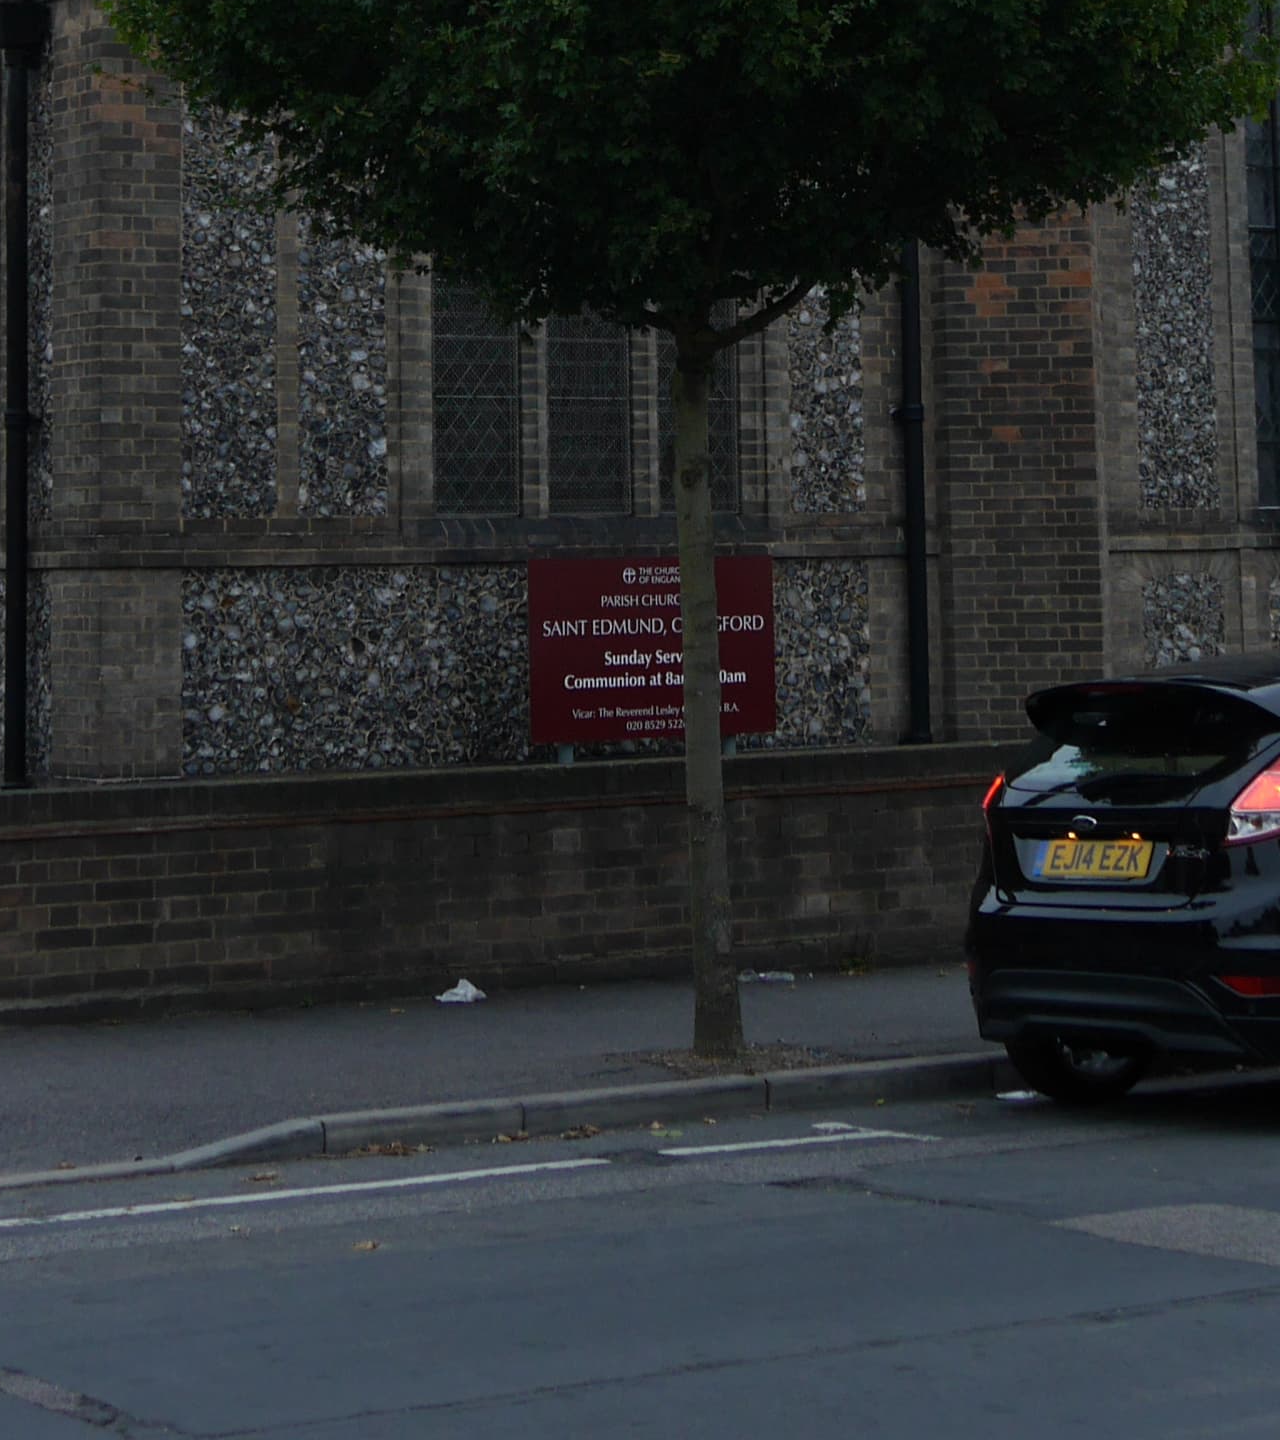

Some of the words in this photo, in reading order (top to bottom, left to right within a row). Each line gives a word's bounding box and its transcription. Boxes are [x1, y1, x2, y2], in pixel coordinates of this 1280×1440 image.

[639, 567, 652, 575] THE
[654, 566, 681, 574] CHURC
[639, 576, 650, 584] OF
[651, 575, 681, 584] ENGLAN
[601, 594, 639, 607] PARISH
[641, 593, 681, 607] CHURC
[542, 619, 588, 637] SAINT
[592, 618, 667, 636] EDMUND,
[604, 649, 652, 670] Sunday
[564, 672, 646, 690] Communion
[649, 673, 662, 687] at
[665, 671, 684, 686] 8a
[719, 669, 747, 683] 0am
[572, 708, 596, 719] Vicar:
[598, 707, 614, 718] The
[616, 705, 654, 717] Reverend
[626, 721, 642, 731] 020
[667, 719, 685, 729] 522
[1050, 844, 1095, 870] EJ14
[1099, 844, 1143, 871] EZK
